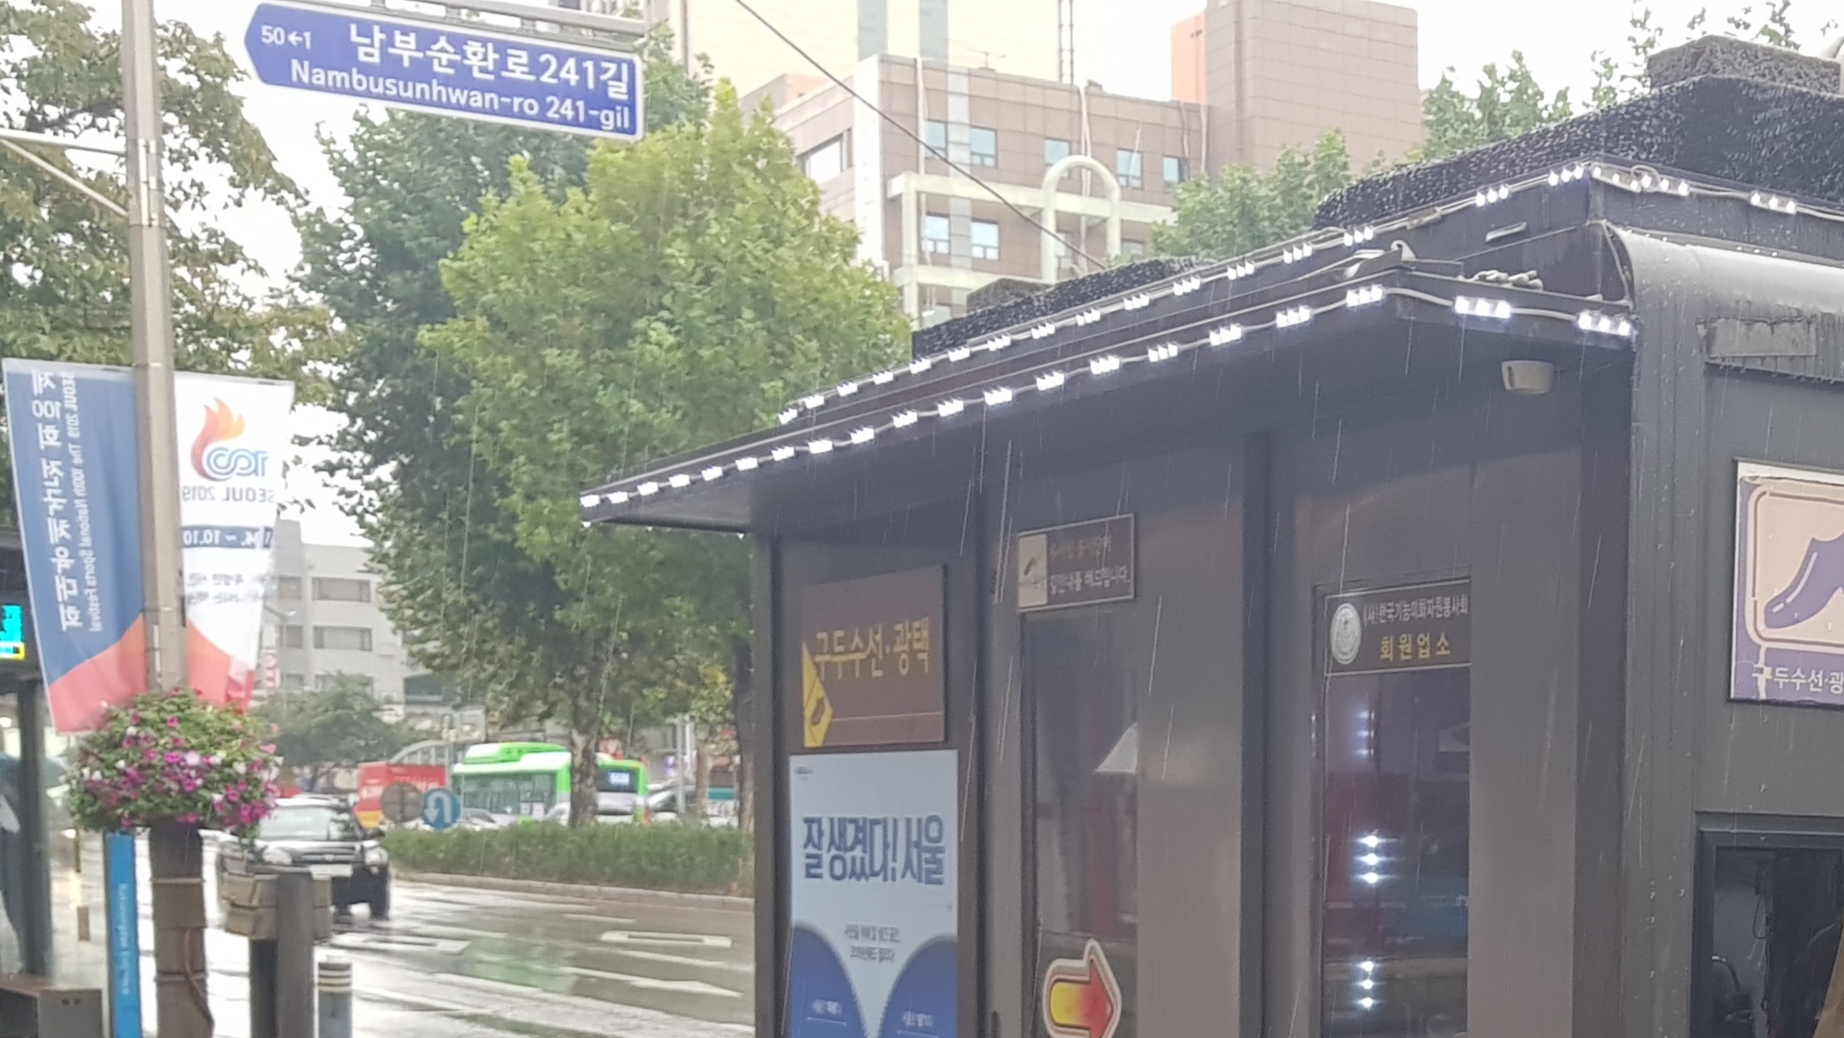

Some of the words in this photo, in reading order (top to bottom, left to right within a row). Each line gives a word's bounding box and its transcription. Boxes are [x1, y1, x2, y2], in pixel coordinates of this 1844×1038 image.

[290, 58, 541, 117] Nambusunhwan-ro
[545, 95, 631, 131] 241-gil
[348, 21, 630, 101] 남부순환로241길
[901, 814, 946, 886] 서울
